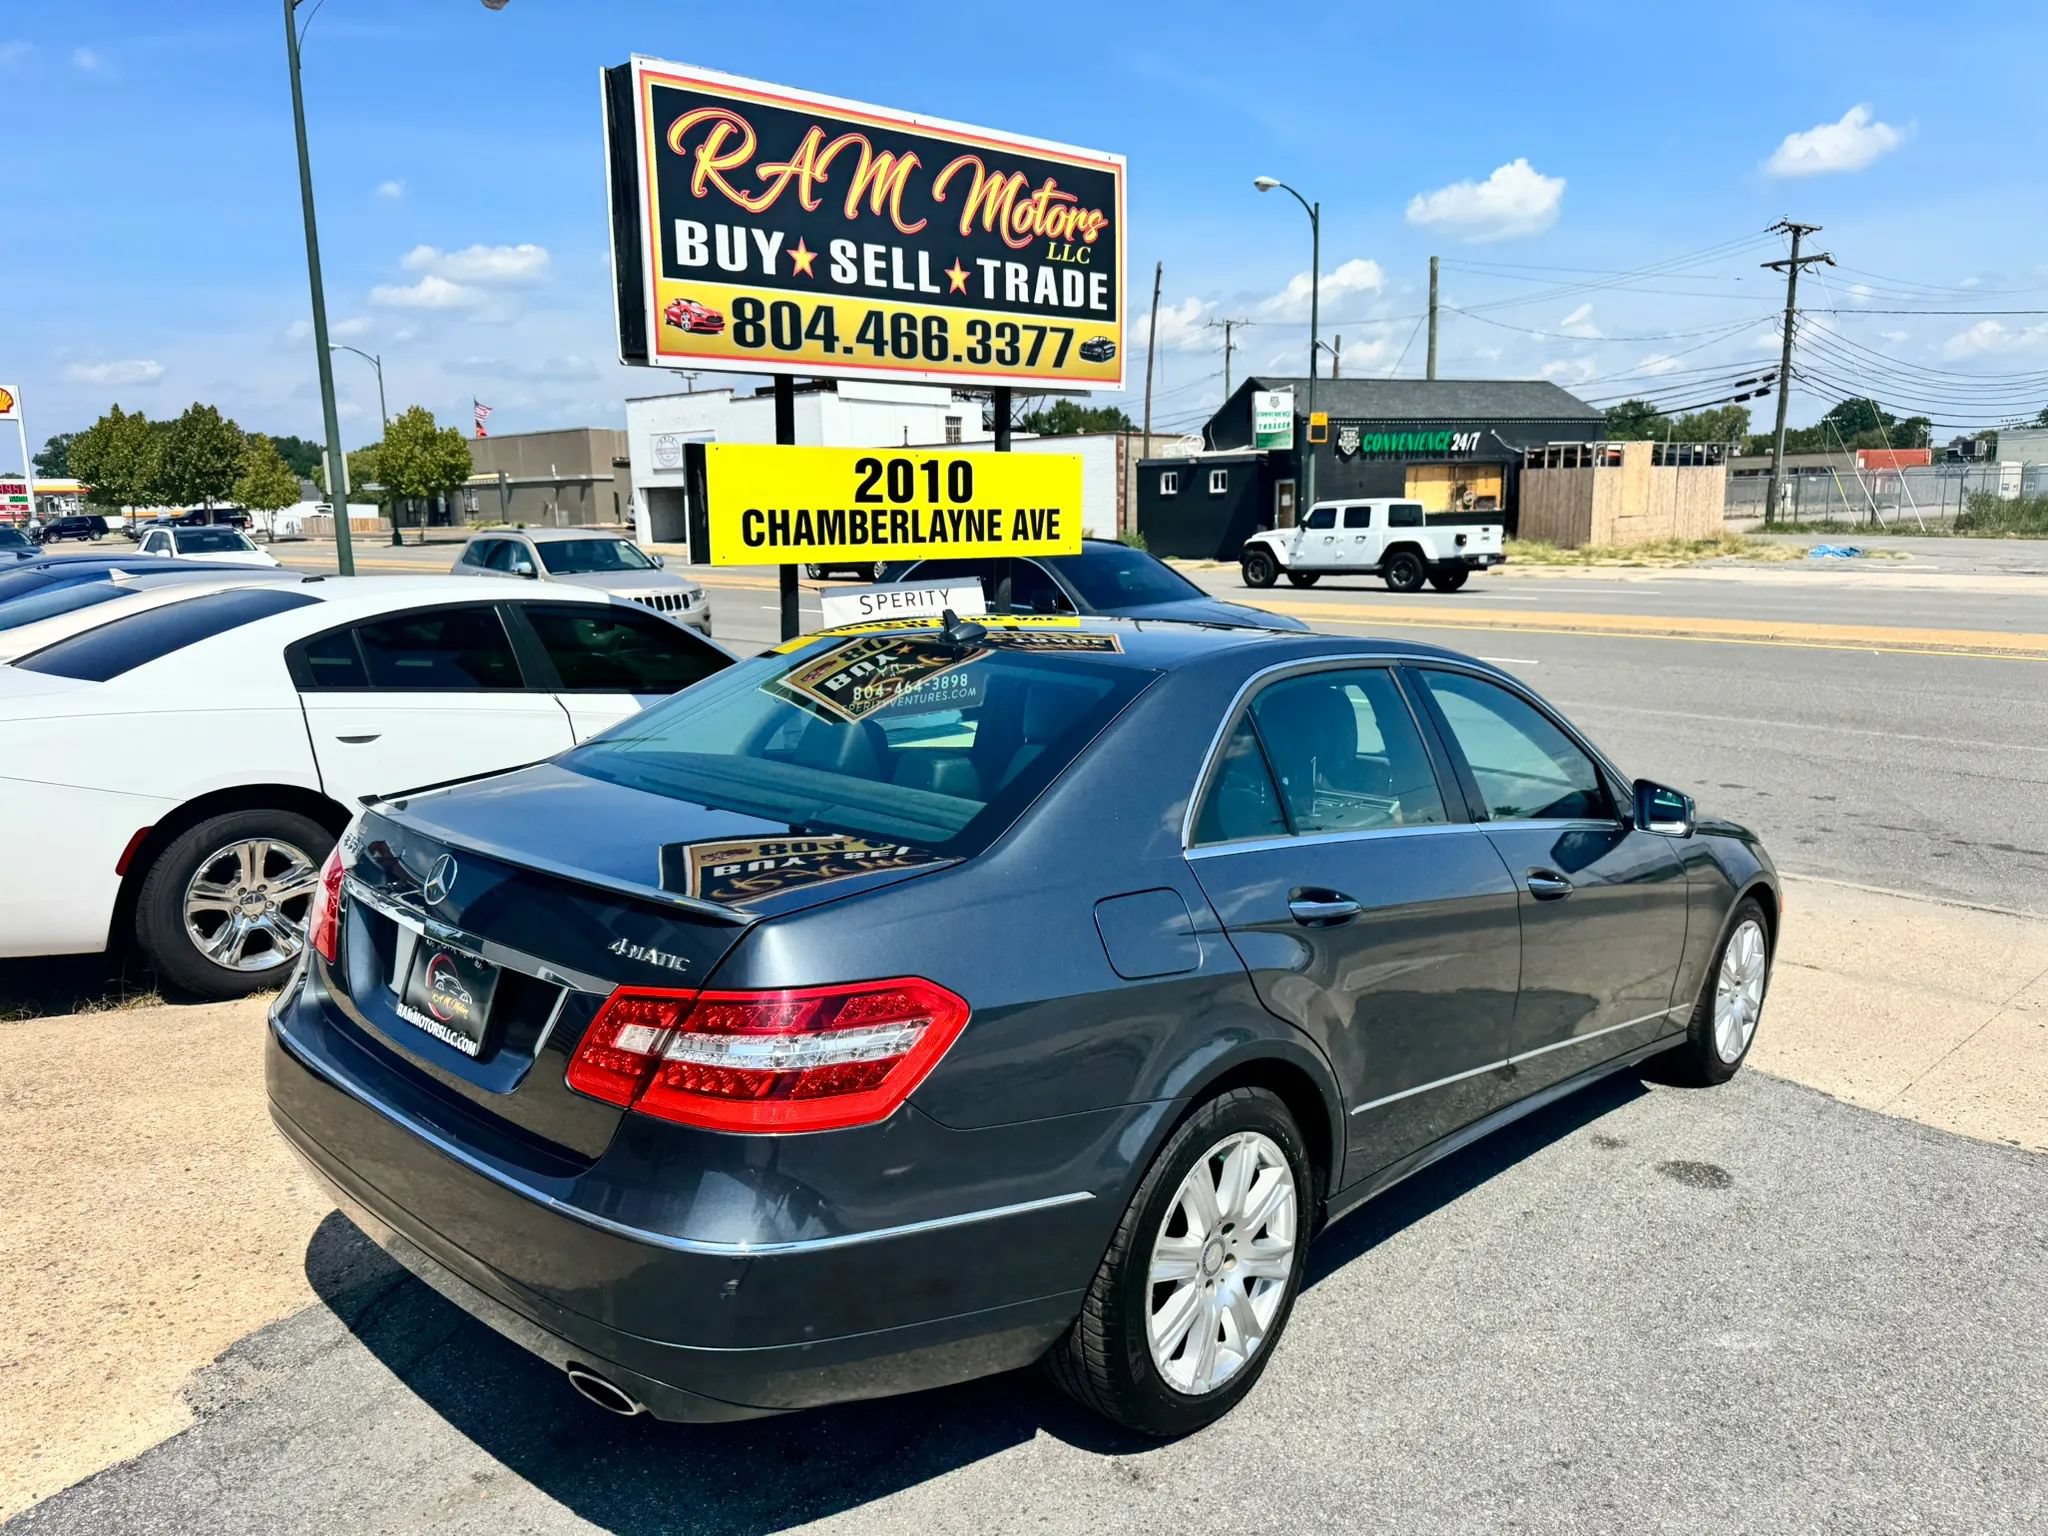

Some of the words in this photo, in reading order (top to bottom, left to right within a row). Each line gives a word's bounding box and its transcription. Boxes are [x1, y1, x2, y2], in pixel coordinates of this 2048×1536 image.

[667, 107, 927, 235] RAM
[932, 154, 1109, 249] Motors
[675, 219, 784, 275] BUY
[829, 238, 941, 294] SELL
[976, 257, 1108, 311] TRADE
[1046, 241, 1092, 265] LLC
[731, 296, 1075, 369] 804.466.3377
[1363, 430, 1455, 453] CONVENIENCE
[1451, 431, 1482, 452] 24/7
[854, 457, 973, 504] 2010
[742, 508, 1002, 547] CHAMBERLAYNE
[1011, 508, 1061, 541] AVE
[859, 588, 950, 615] SPERITY
[853, 673, 968, 701] 804-464-3898
[607, 938, 691, 972] 4MATIC
[396, 1002, 478, 1057] RAMMOTORSLLC.COM
